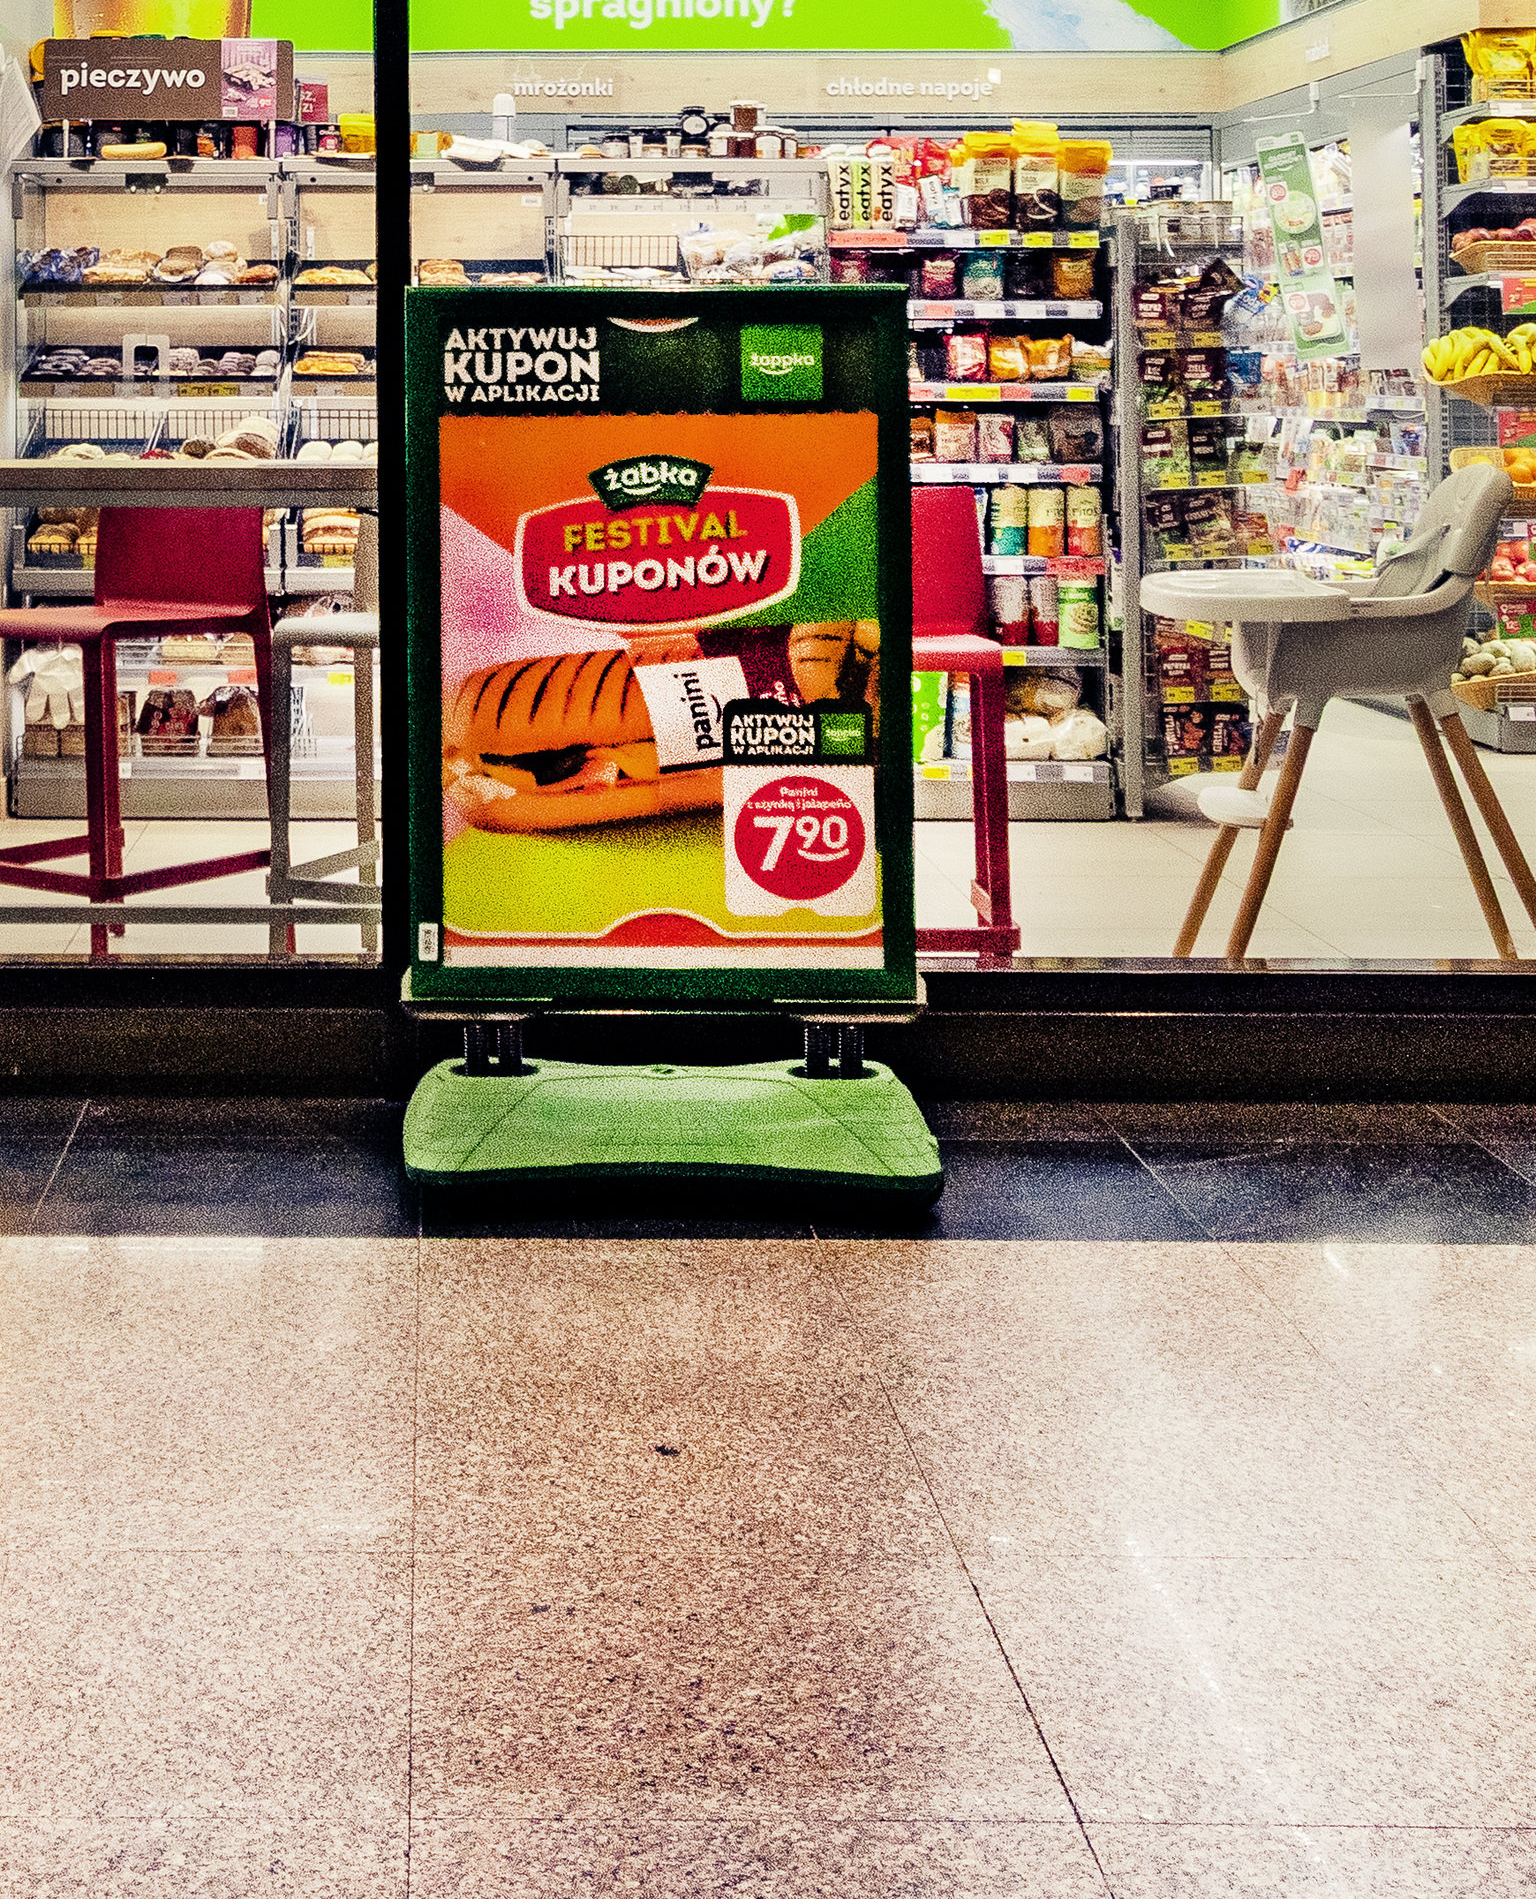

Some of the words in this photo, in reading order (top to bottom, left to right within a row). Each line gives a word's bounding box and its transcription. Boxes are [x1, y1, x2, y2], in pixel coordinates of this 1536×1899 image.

[60, 62, 206, 96] pieczywo
[514, 77, 614, 99] mrożonki
[827, 76, 914, 98] chłodne
[919, 78, 993, 102] napoje
[835, 164, 850, 222] eatyx
[856, 164, 871, 222] eatyx
[878, 164, 893, 222] eatyx
[444, 327, 598, 352] AKTYWUJ
[444, 351, 600, 384] KUPON
[749, 351, 815, 372] żappka
[445, 386, 468, 402] W
[471, 384, 600, 403] APLIKACJI
[603, 462, 699, 492] żabka
[563, 510, 748, 553] FESTIVAL
[547, 544, 771, 598] KUPONÓW
[674, 671, 722, 752] panini
[730, 714, 813, 728] AKTYWUJ
[730, 728, 815, 745] KUPON
[732, 745, 745, 755] W
[747, 744, 813, 756] APLIKACJI
[755, 800, 795, 813] szynką
[802, 798, 851, 813] jalapeño
[780, 785, 818, 798] Panini
[753, 815, 849, 871] 790
